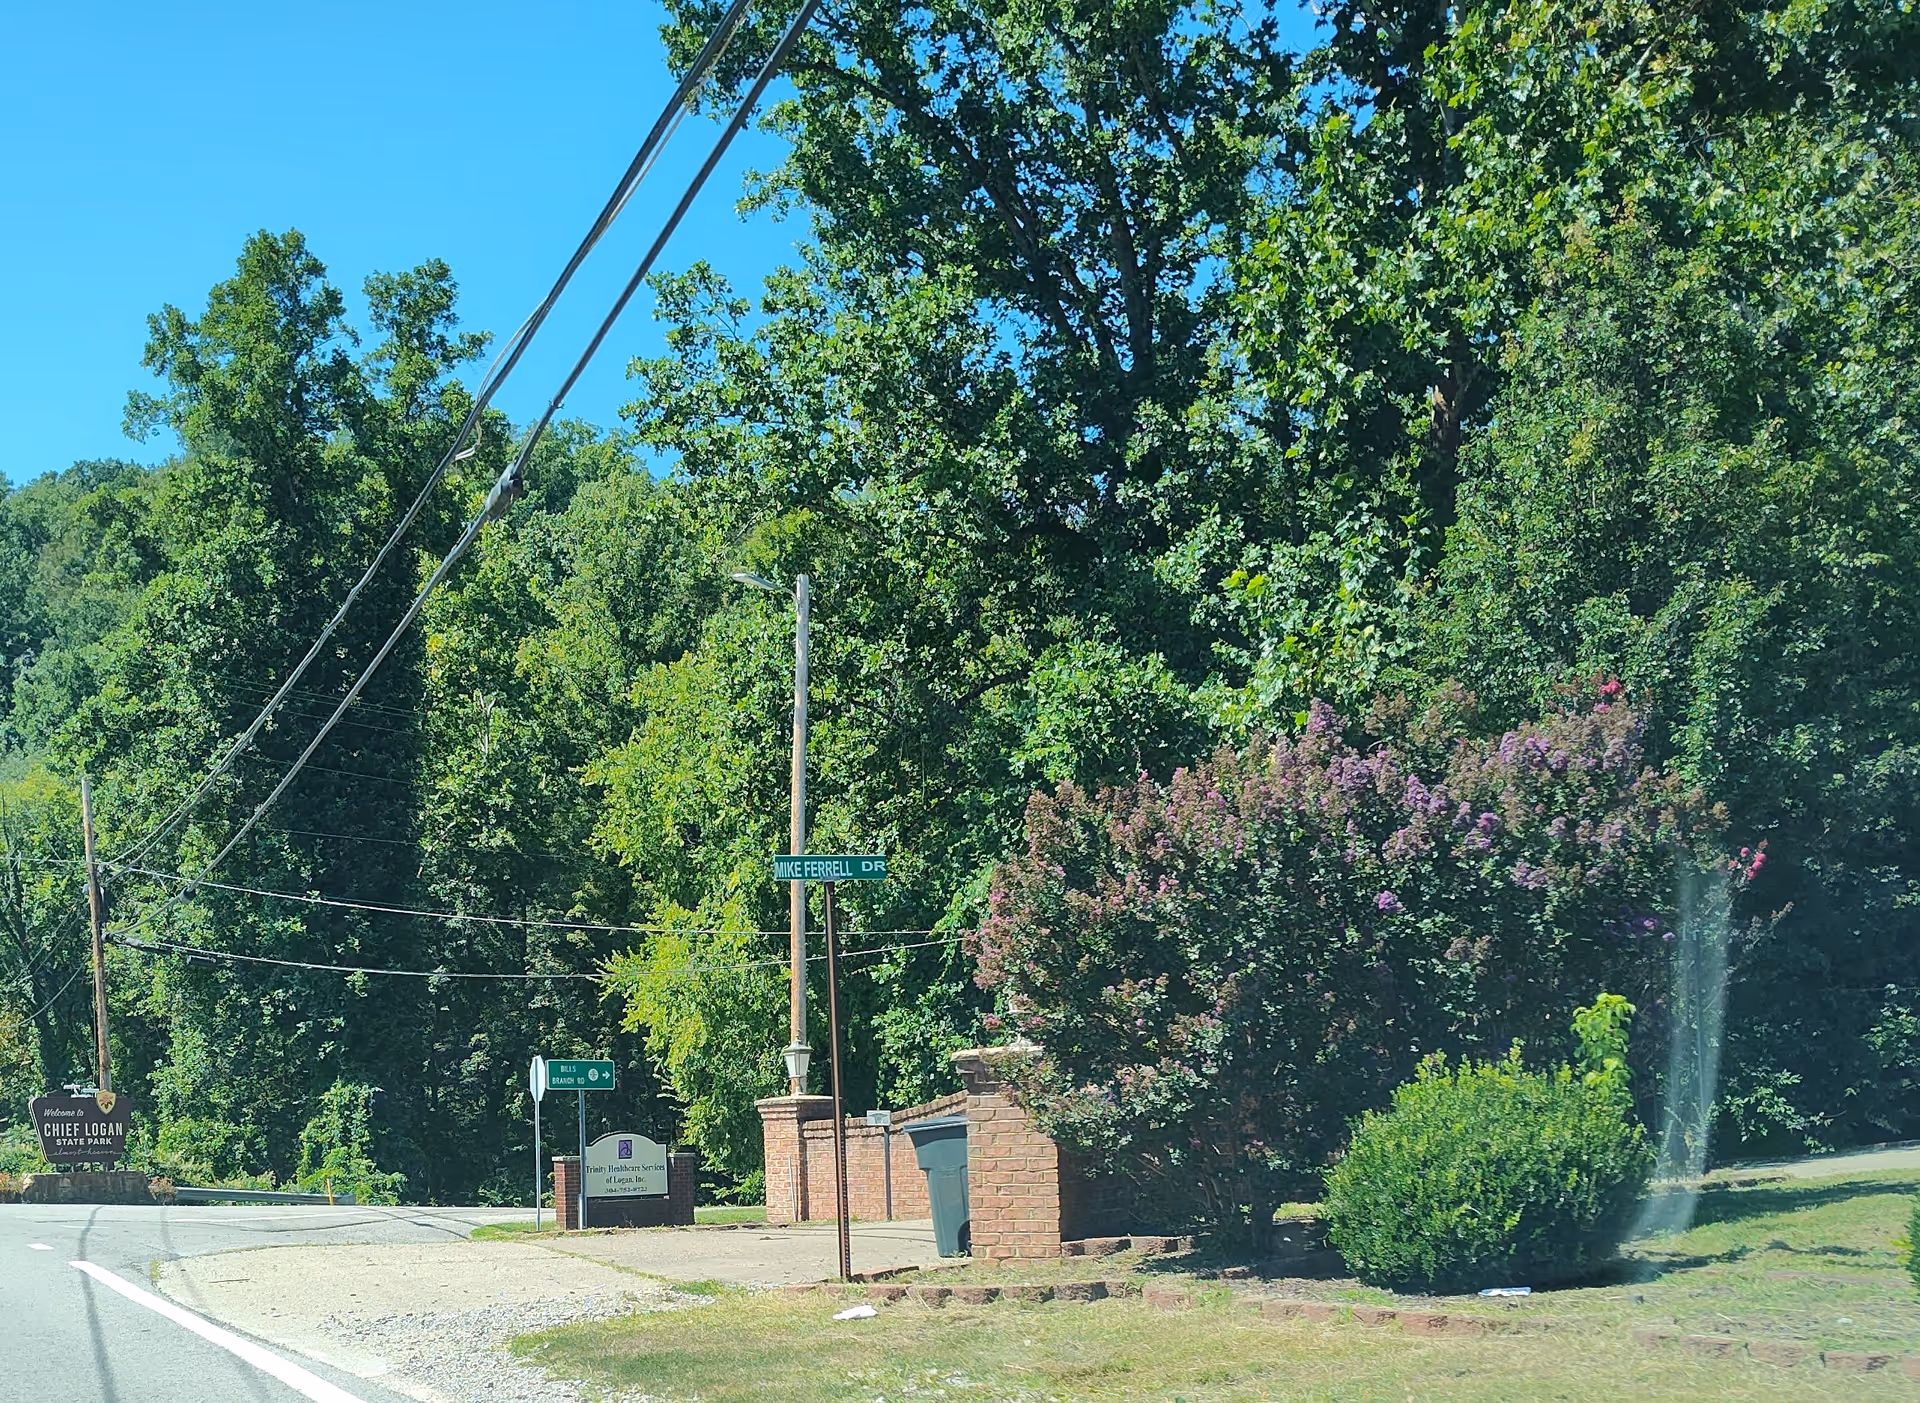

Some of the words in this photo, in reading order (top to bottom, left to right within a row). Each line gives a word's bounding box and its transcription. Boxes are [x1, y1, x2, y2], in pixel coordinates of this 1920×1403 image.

[774, 861, 802, 878] MIKE
[803, 860, 853, 877] FERRELL
[861, 861, 886, 872] DR
[551, 1077, 575, 1085] BRANCH
[43, 1108, 76, 1117] Welcome
[76, 1108, 84, 1117] to
[43, 1122, 80, 1137] CHIEF
[84, 1122, 123, 1136] LOGAN
[55, 1138, 85, 1146] STATE
[87, 1137, 112, 1145] PARK
[585, 1165, 606, 1175] Trinity
[608, 1164, 641, 1173] Healthcare
[641, 1163, 665, 1171] Services
[605, 1176, 613, 1184] of
